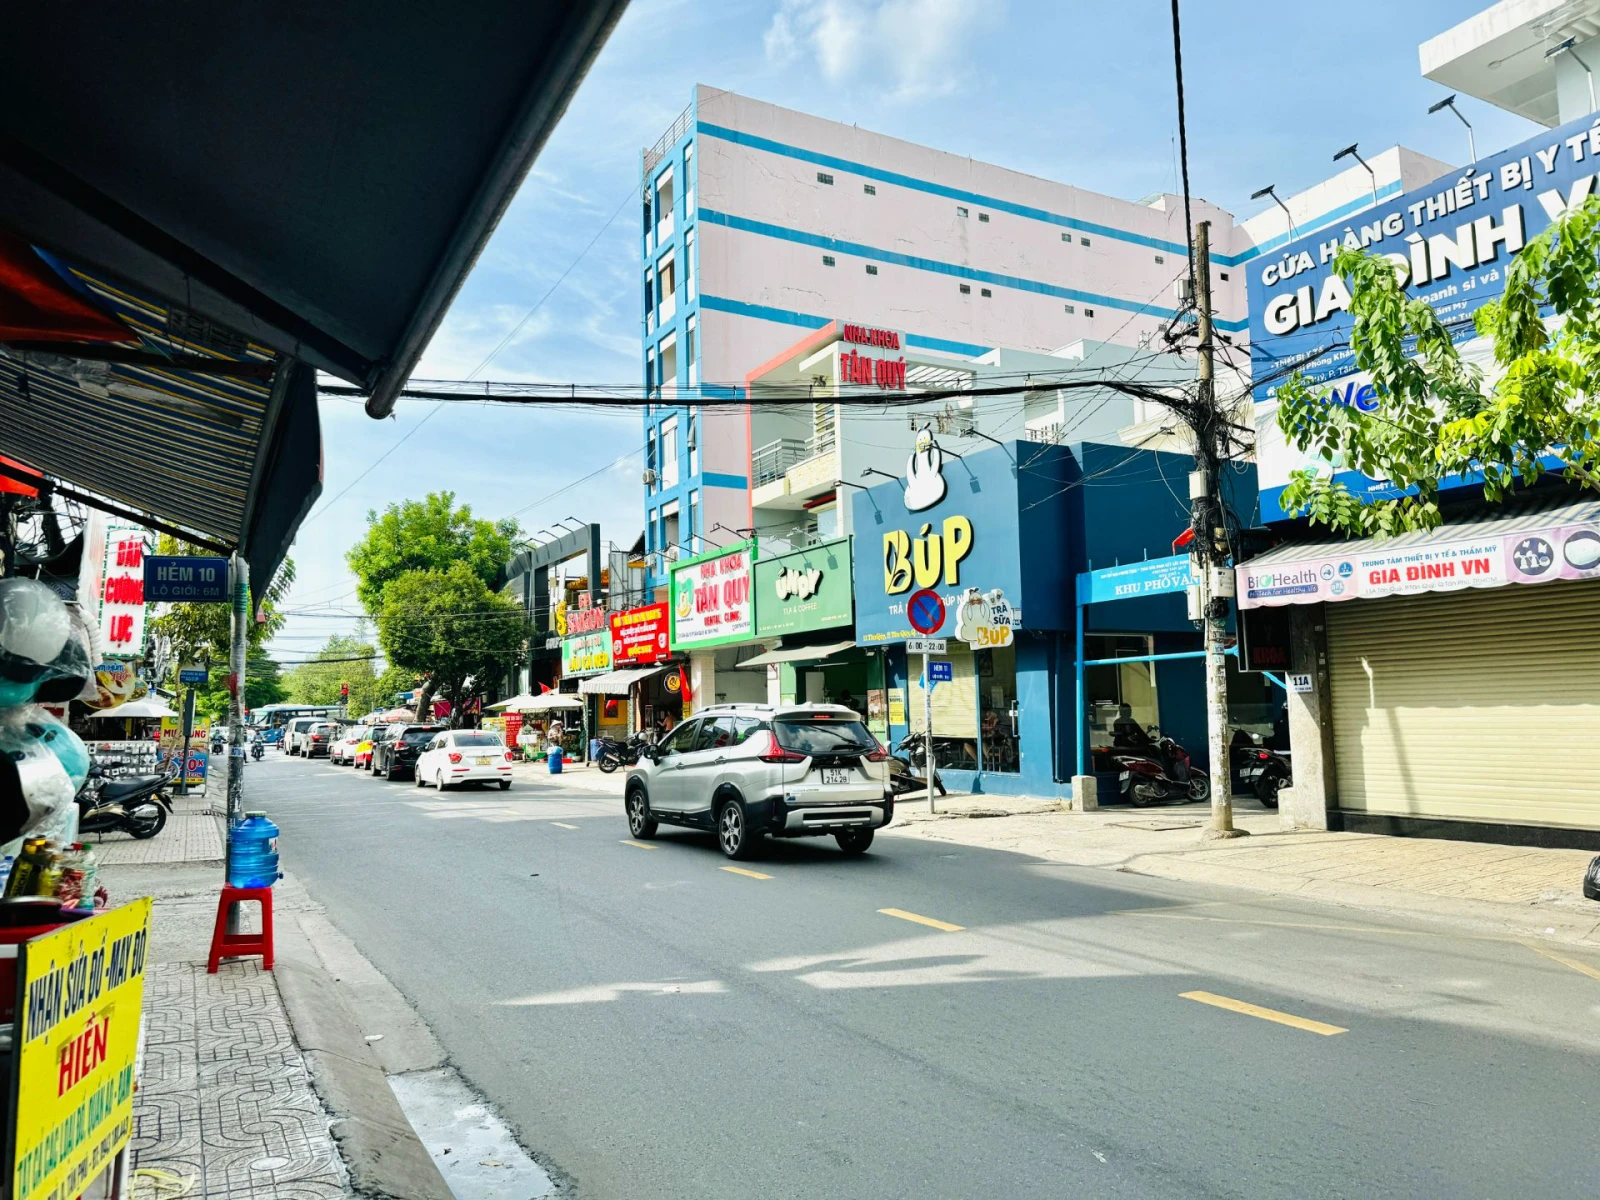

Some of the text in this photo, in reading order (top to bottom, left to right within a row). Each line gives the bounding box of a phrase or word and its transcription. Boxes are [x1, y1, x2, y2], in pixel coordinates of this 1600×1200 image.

[1261, 250, 1316, 286] CỬA
[1319, 212, 1405, 264] HÀNG
[1407, 168, 1493, 226] THIẾT
[1500, 156, 1533, 191] BỊ
[1535, 143, 1560, 174] Y
[1480, 269, 1500, 285] và
[1263, 274, 1353, 335] GIA
[870, 328, 900, 351] KHOA
[840, 349, 906, 391] TÂN QUÝ
[1306, 356, 1332, 371] Phòng
[883, 515, 972, 594] BÚP
[1362, 559, 1385, 568] TRUNG
[1387, 557, 1403, 565] TÂM
[1405, 553, 1424, 562] THIẾT
[1425, 553, 1432, 561] BỊ
[1441, 549, 1449, 558] TẾ
[1460, 545, 1483, 556] THẨM
[1485, 545, 1498, 553] MỸ
[157, 562, 216, 582] HẺM 10
[1369, 558, 1490, 585] GIA ĐÌNH VN
[1115, 582, 1141, 596] KHU
[991, 602, 1008, 615] TRÀ
[993, 615, 1011, 625] SỮA
[977, 625, 1010, 646] BÚP
[928, 642, 944, 651] 22:00
[1293, 676, 1309, 686] 11A
[830, 768, 842, 776] 51K
[25, 959, 65, 1045] NHẬN
[65, 939, 88, 1018] SỬA
